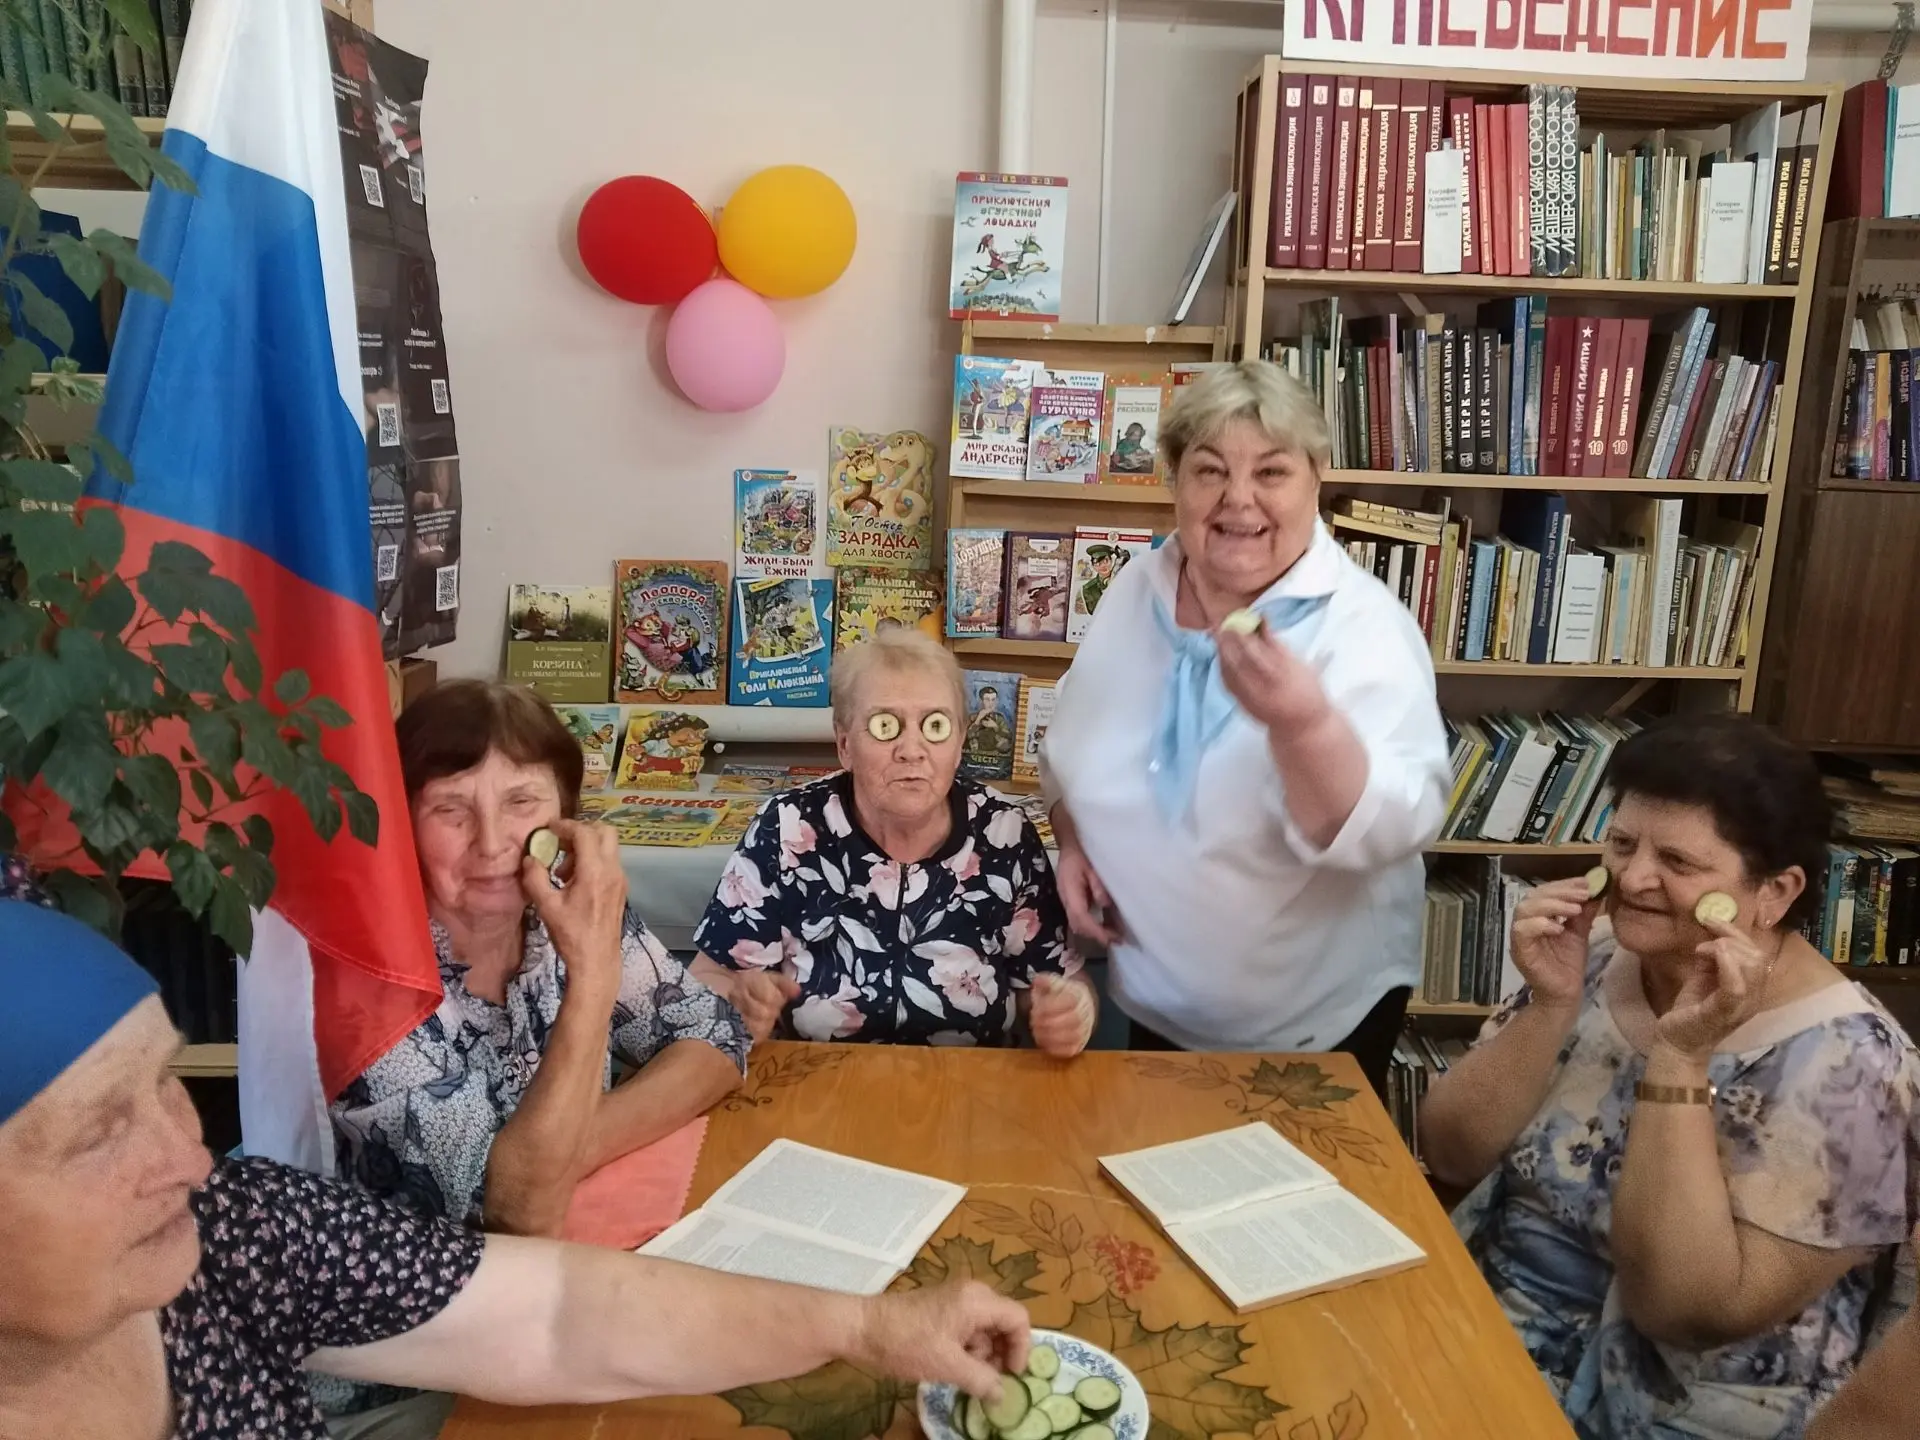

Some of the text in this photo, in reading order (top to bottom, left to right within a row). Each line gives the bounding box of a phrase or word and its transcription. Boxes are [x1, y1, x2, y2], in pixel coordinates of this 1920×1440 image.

[1529, 95, 1543, 167] СТОРОНА
[1546, 97, 1560, 168] СТОРОНА
[1561, 100, 1576, 170] СТОРОНА
[1284, 117, 1297, 237] РЯЗАНСКАЯ ЭНЦИКЛОПЕДИЯ
[1310, 116, 1323, 235] РЯЗАНСКАЯ ЭНЦИКЛОПЕДИЯ
[1336, 121, 1349, 240] РЯЗАНСКАЯ ЭНЦИКЛОПЕДИЯ
[1355, 118, 1369, 237] РЯЗАНСКАЯ ЭНЦИКЛОПЕДИЯ
[1375, 111, 1389, 238] РЯЖСКАЯ ЭНЦИКЛОПЕДИЯ
[1404, 113, 1418, 239] РЯЖСКАЯ ЭНЦИКЛОПЕДИЯ
[971, 195, 1051, 208] ПРИКЛЮЧЕНИЯ
[980, 207, 1042, 218] ОГУРЕЧНОЙ
[1462, 166, 1472, 257] КРАСНАЯ КНИГА
[1771, 161, 1791, 261] ИСТОРИЯ РЯЗАНСКОГО КРАЯ
[1790, 158, 1812, 259] ИСТОРИЯ РЯЗАНСКОГО КРАЯ
[984, 217, 1037, 228] ЛОШАДКИ
[1443, 342, 1452, 368] БЫТЬ
[1575, 342, 1591, 433] КНИГА ПАМЯТИ
[1040, 406, 1096, 416] БУРАТИНО
[1431, 390, 1441, 467] РЯЗАНСКАЯ
[966, 442, 1028, 455] МИР СКАЗОК
[1588, 440, 1604, 455] 10
[1612, 440, 1628, 455] 10
[838, 530, 919, 549] ЗАРЯДКА
[1550, 512, 1559, 539] России
[843, 548, 913, 560] ДЛЯ ХВОСТА
[955, 536, 1002, 565] ЛОВУШКА
[640, 584, 707, 607] Леопард
[864, 578, 916, 588] БОЛЬШАЯ
[532, 660, 583, 669] КОРЗИНА
[971, 754, 998, 764] ЧЕСТЬ
